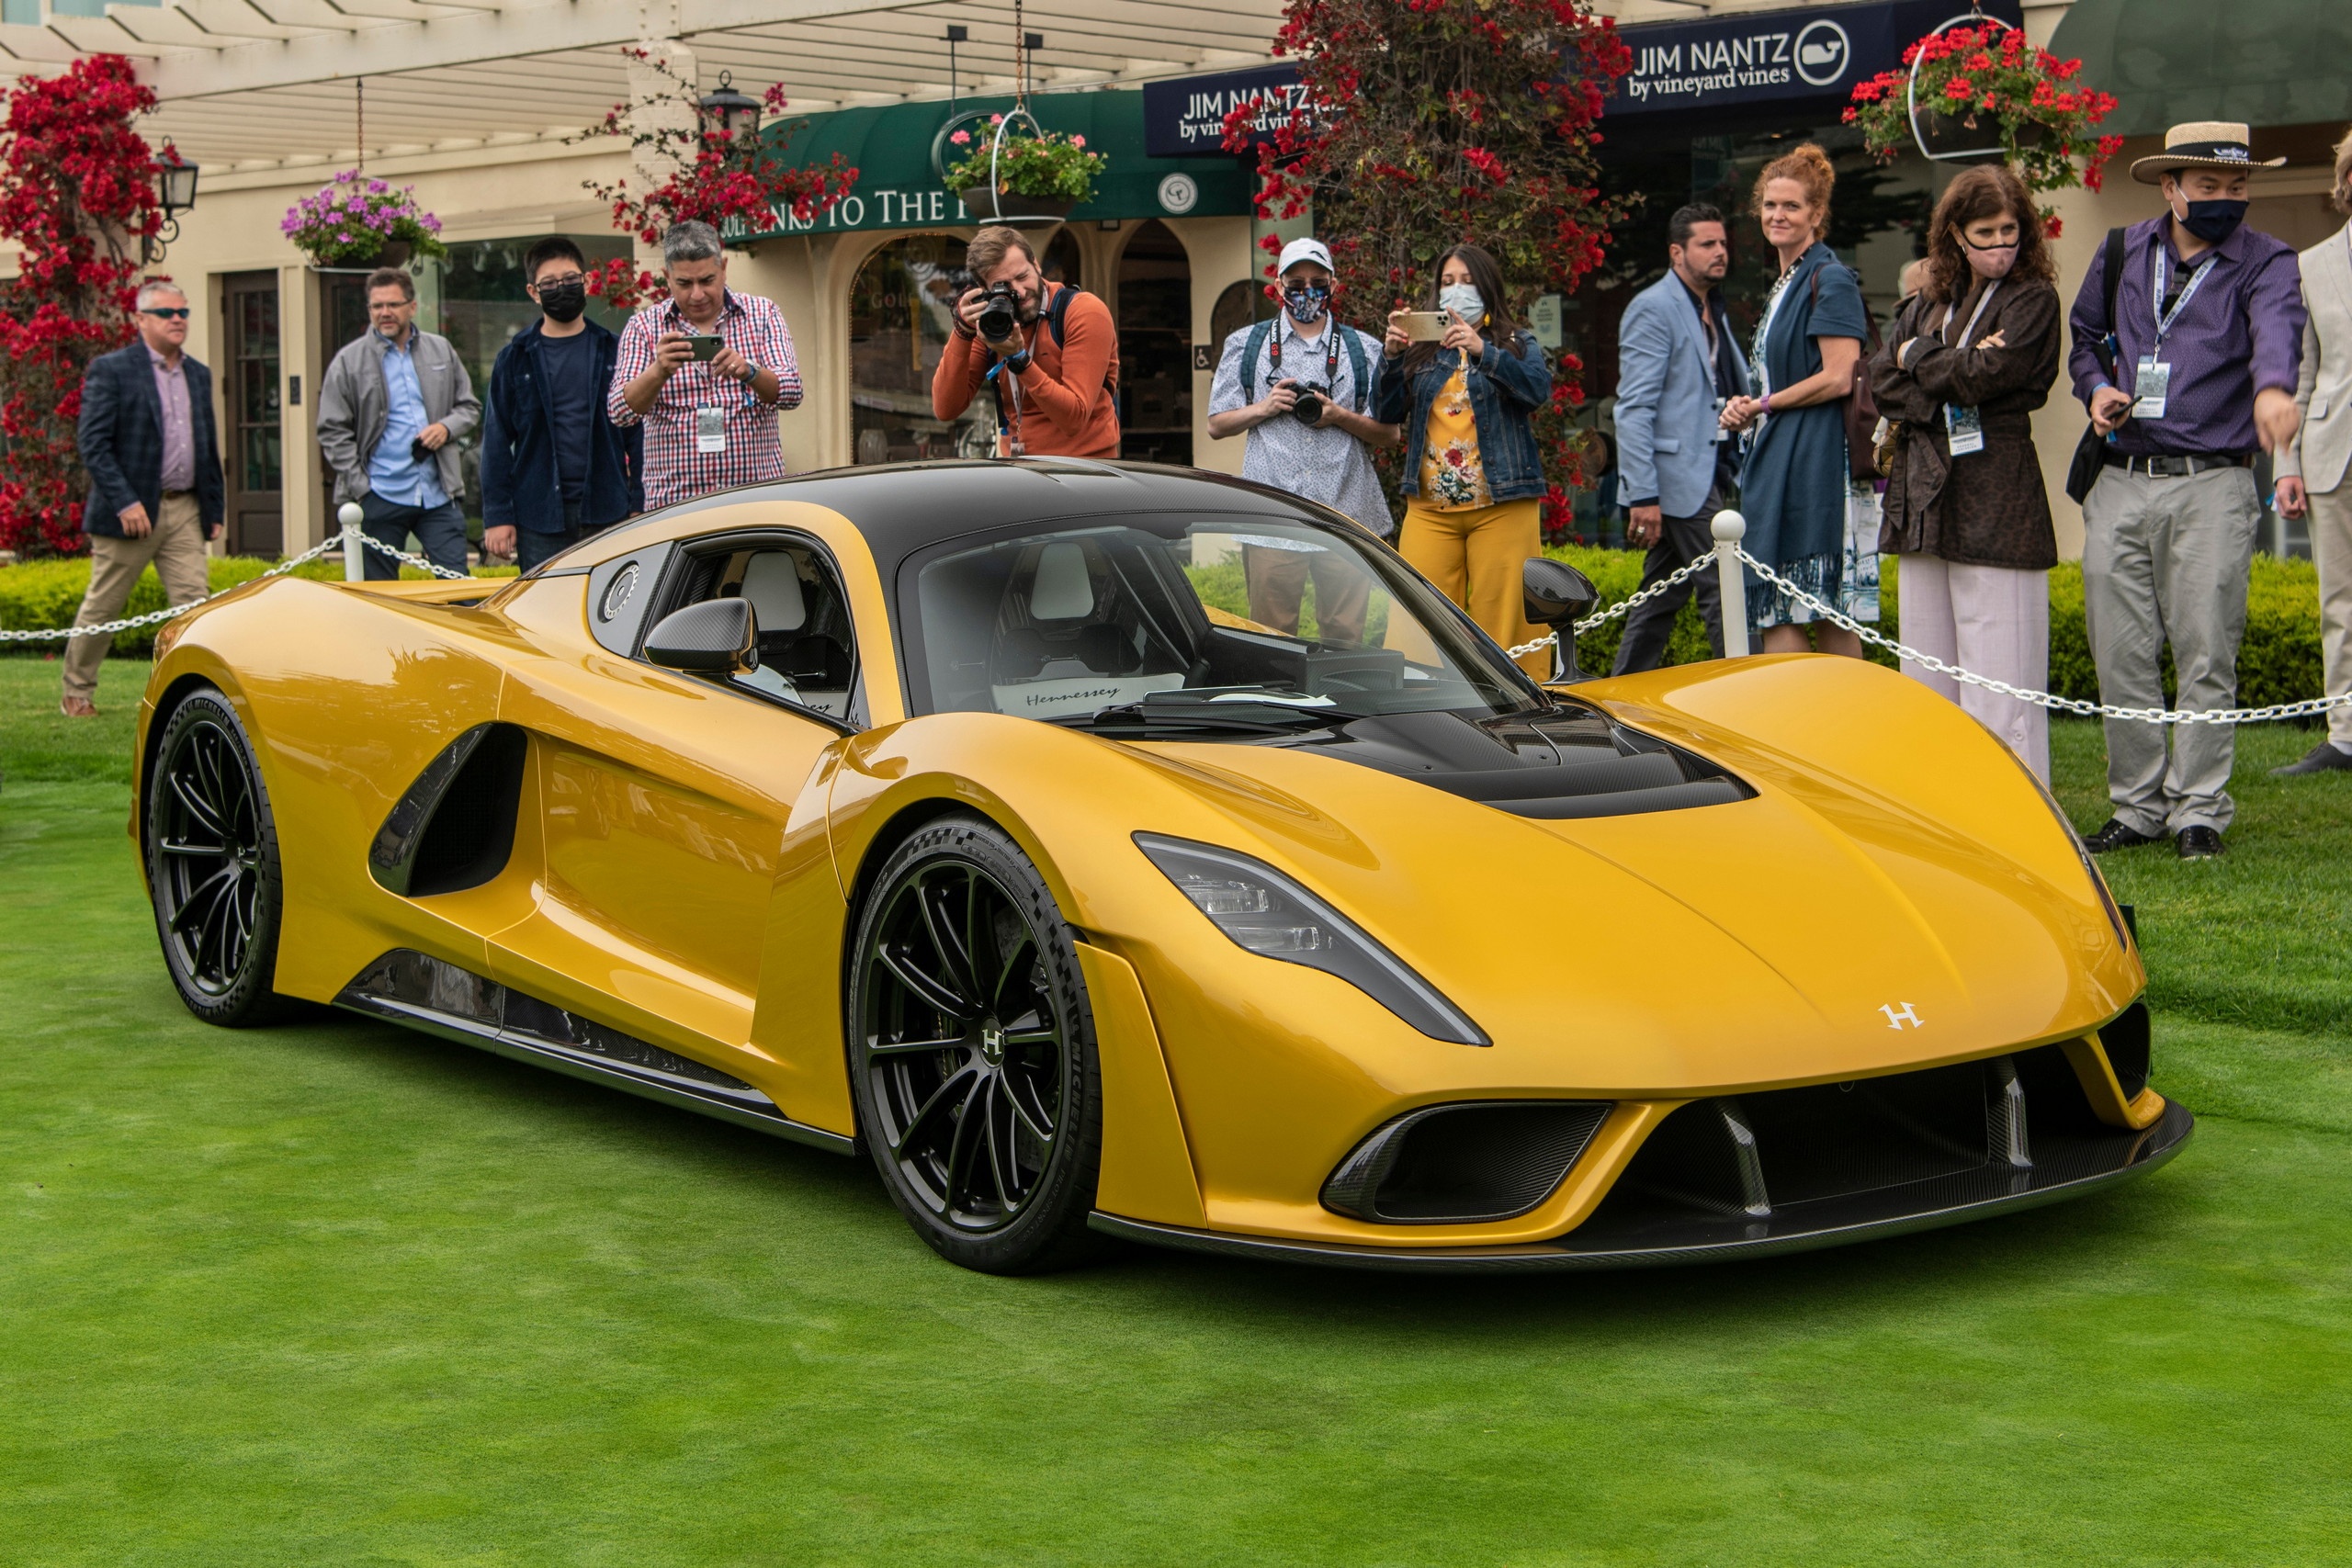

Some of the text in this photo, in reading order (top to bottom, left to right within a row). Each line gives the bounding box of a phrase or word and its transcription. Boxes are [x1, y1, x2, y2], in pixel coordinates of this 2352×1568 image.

[1634, 32, 1790, 77] JIM NANTZ
[1628, 66, 1791, 103] by vineyard vines
[1183, 91, 1222, 119] JIM
[1179, 111, 1311, 143] by vinrd vins
[752, 199, 814, 234] NKS
[875, 189, 945, 223] THE
[1329, 333, 1340, 357] LUMIX
[1026, 687, 1122, 706] Hennessey
[194, 698, 231, 728] MICHELIN
[1065, 1041, 1083, 1162] MICHELIN
